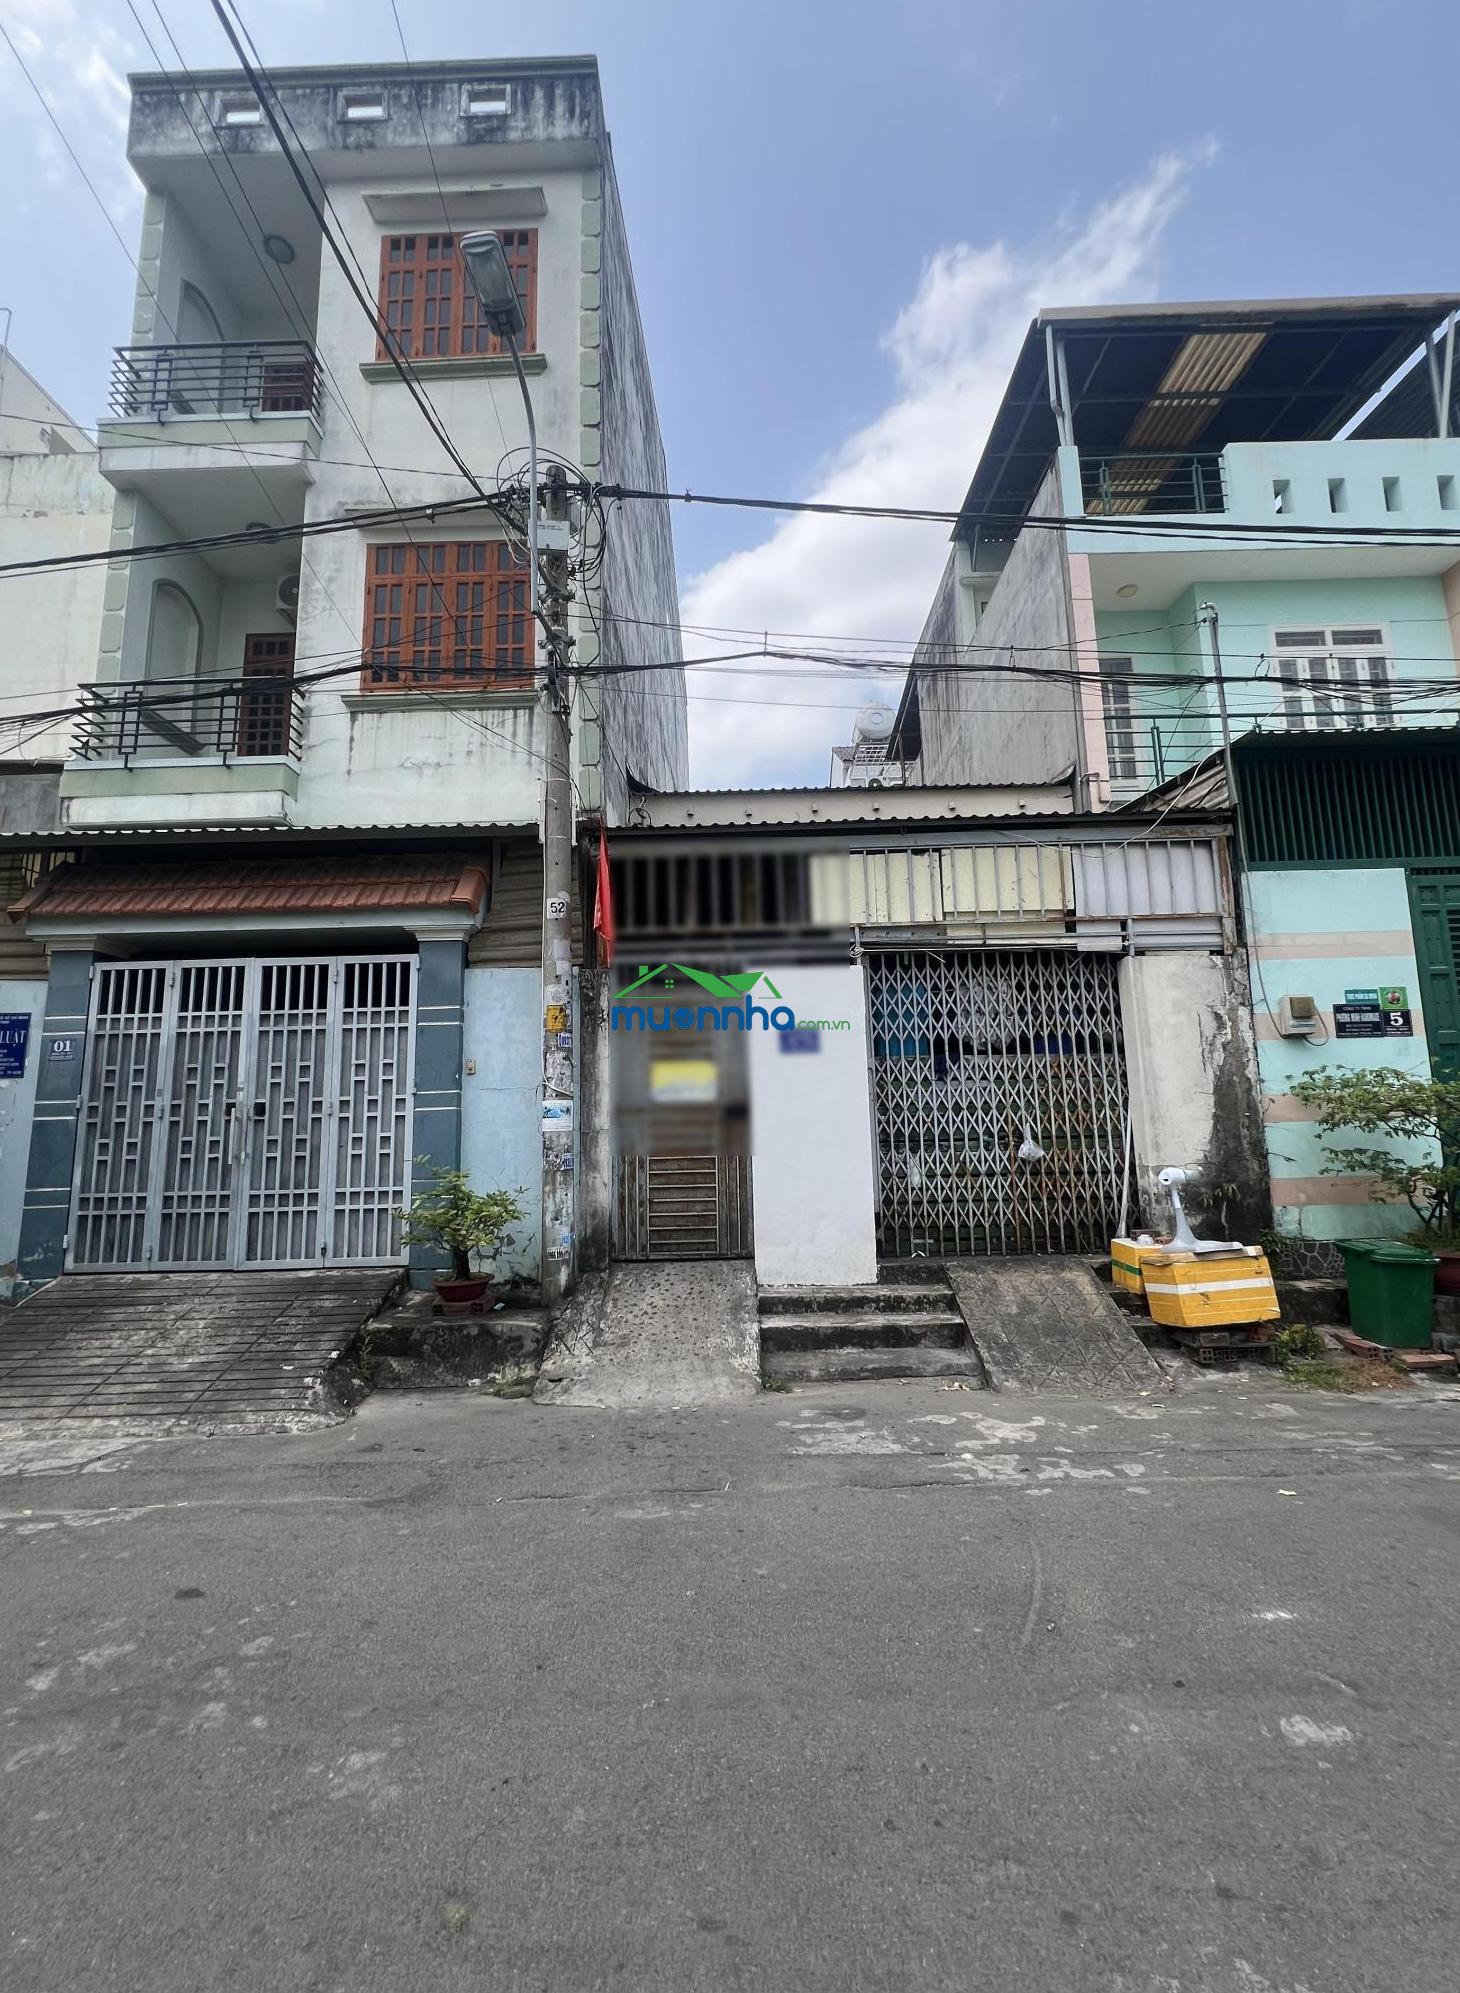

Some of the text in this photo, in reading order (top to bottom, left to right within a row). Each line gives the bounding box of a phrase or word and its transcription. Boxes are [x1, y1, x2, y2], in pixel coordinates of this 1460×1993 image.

[550, 902, 566, 914] 52
[1390, 1012, 1404, 1026] 5
[53, 1040, 72, 1052] 01
